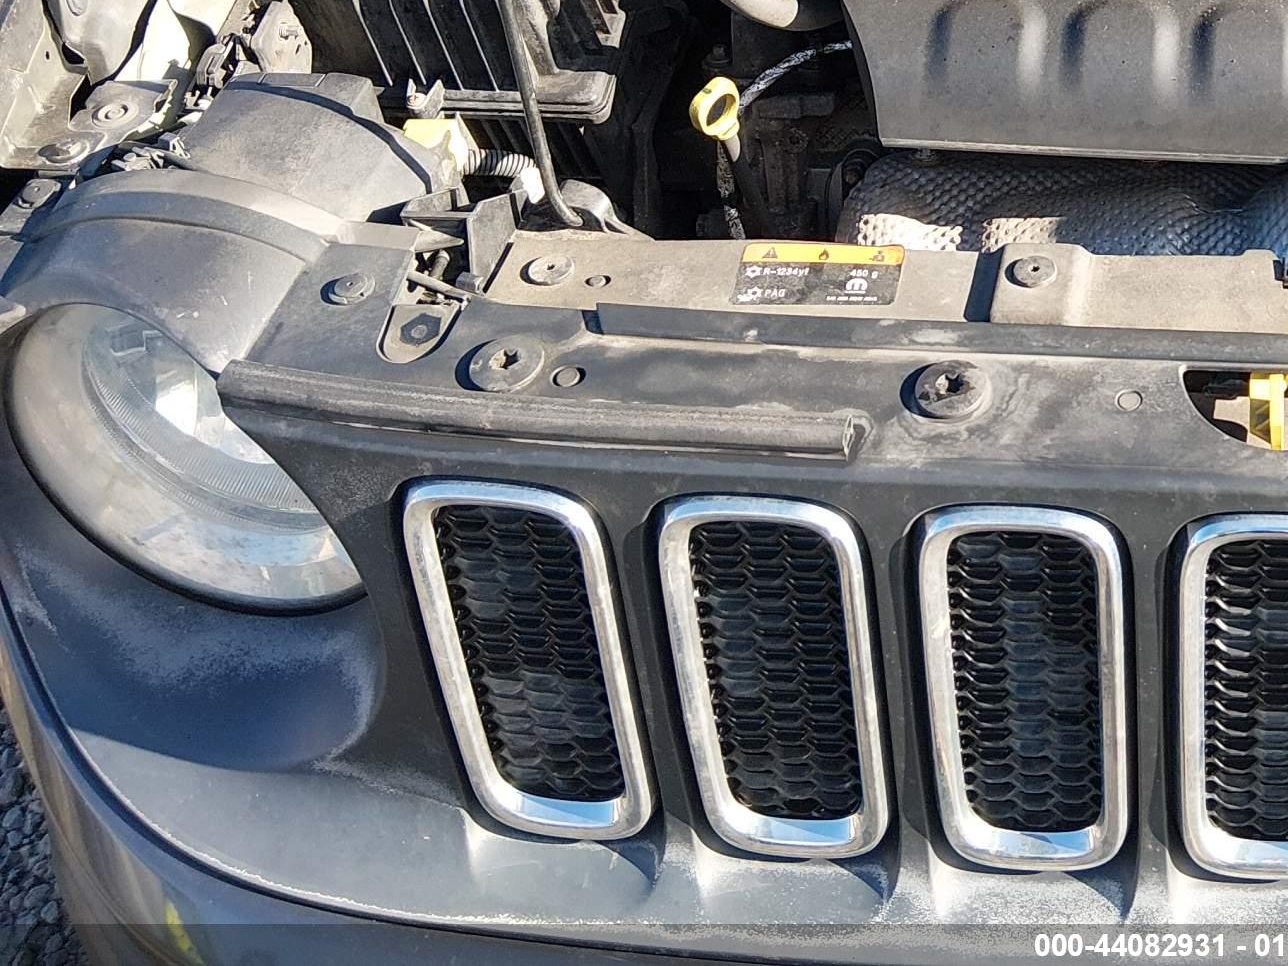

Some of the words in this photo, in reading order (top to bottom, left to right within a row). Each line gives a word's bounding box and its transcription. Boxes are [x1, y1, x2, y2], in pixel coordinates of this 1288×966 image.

[763, 267, 810, 277] R-1234yf
[849, 269, 869, 277] 450
[764, 288, 786, 298] PAG
